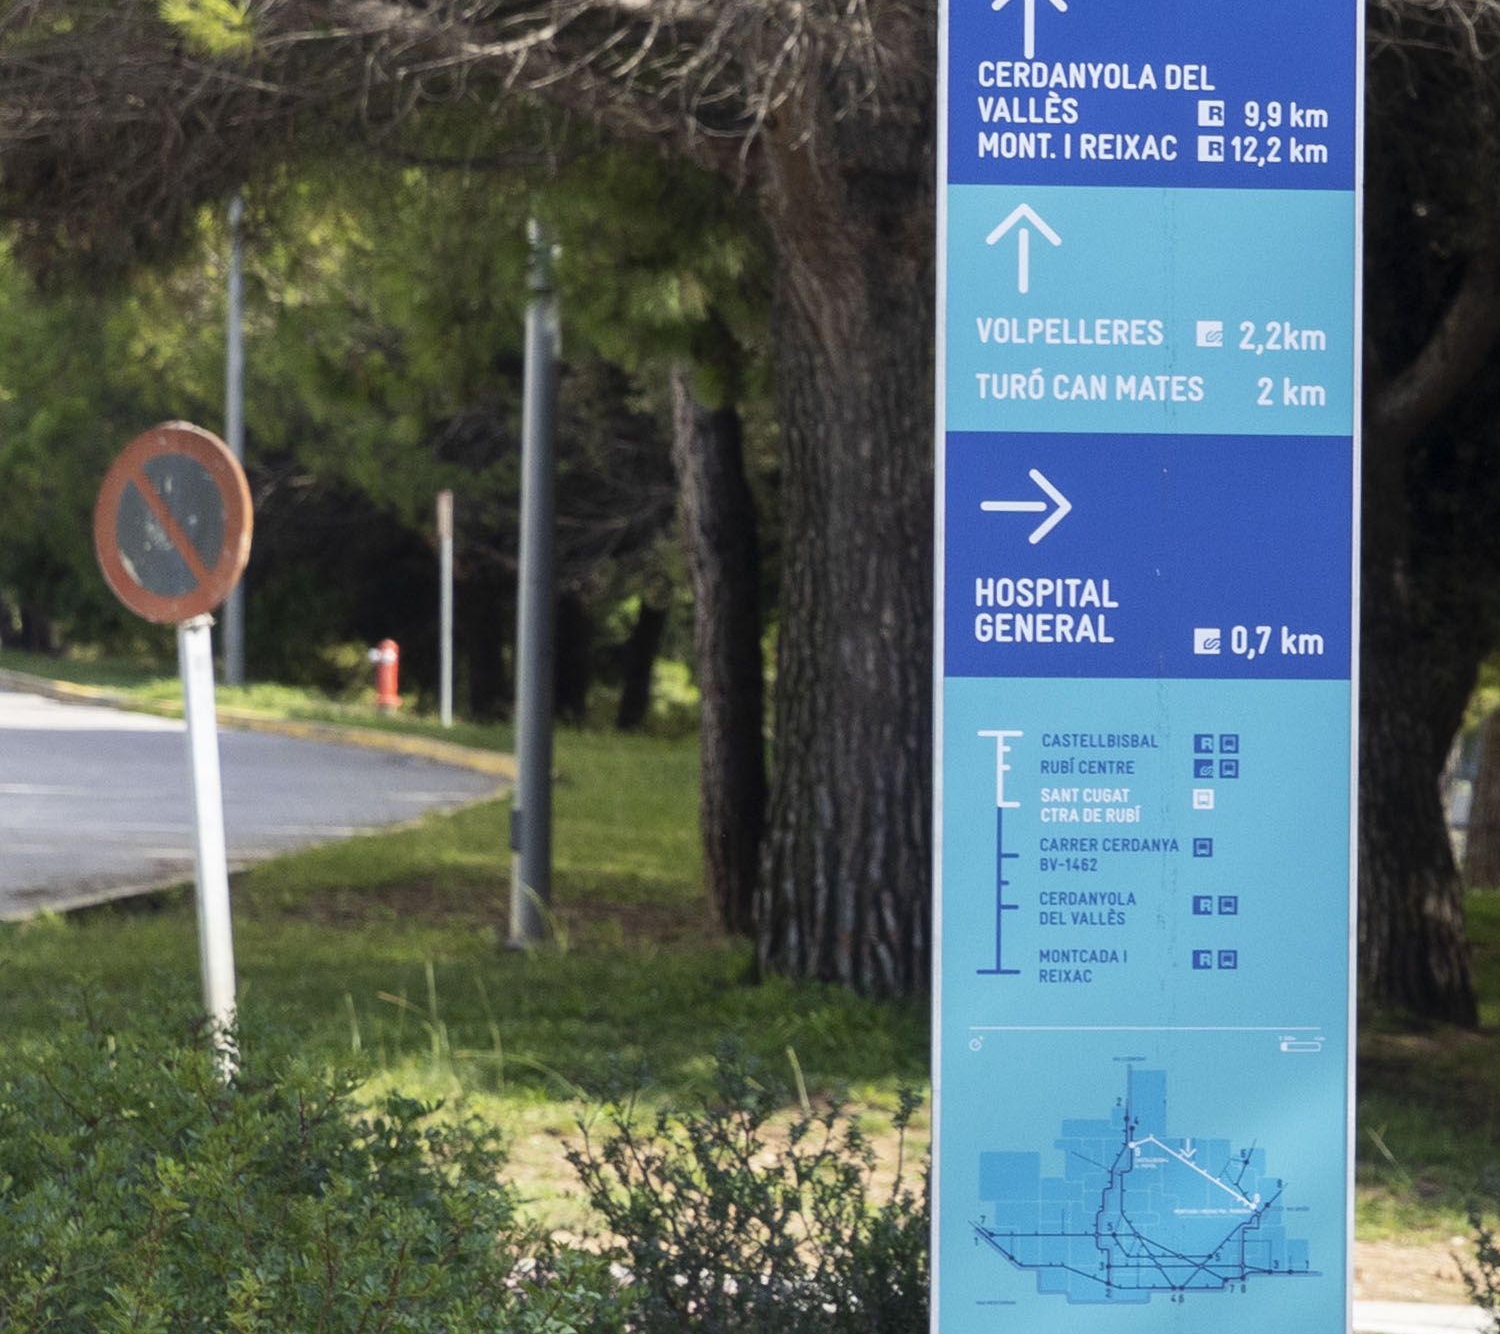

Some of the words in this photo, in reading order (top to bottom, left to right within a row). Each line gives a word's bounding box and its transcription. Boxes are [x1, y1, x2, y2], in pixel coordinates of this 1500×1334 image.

[978, 60, 1157, 94] CERDANYOLA
[1165, 64, 1216, 91] DEL
[977, 90, 1079, 124] VALLÈS
[1244, 100, 1282, 132] 9,9
[1290, 101, 1328, 128] km
[978, 131, 1056, 159] MONT.
[1064, 133, 1071, 159] I
[1080, 133, 1178, 161] REIXAC
[1231, 135, 1282, 167] 12,2
[1289, 136, 1328, 163] km
[976, 317, 1164, 346] VOLPELLERES
[1239, 320, 1326, 356] 2,2km
[975, 367, 1045, 400] TURÓ
[1053, 374, 1107, 401] CAN
[1115, 375, 1204, 402] MATES
[1257, 376, 1274, 406] 2
[1283, 377, 1326, 406] km
[975, 577, 1119, 608] HOSPITAL
[974, 612, 1115, 643] GENERAL
[1231, 625, 1272, 660] 0,7
[1281, 625, 1324, 655] km
[1042, 733, 1159, 749] CASTELLBISBAL
[1040, 756, 1075, 775] RUBÍ
[1078, 759, 1135, 775] CENTRE
[1040, 787, 1079, 803] SANT
[1083, 788, 1130, 803] CUGAT
[1040, 807, 1079, 823] CTRA
[1082, 807, 1102, 823] DE
[1105, 805, 1141, 823] RUBÍ
[1039, 837, 1099, 852] CARRER
[1102, 837, 1180, 852] CERDANYA
[1039, 857, 1098, 872] BV-1462
[1039, 891, 1137, 906] CERDANYOLA
[1039, 911, 1067, 926] DEL
[1070, 908, 1126, 926] VALLÈS
[1039, 949, 1120, 964] MONTCADA
[1123, 949, 1128, 964] I
[1039, 968, 1093, 983] REIXAC
